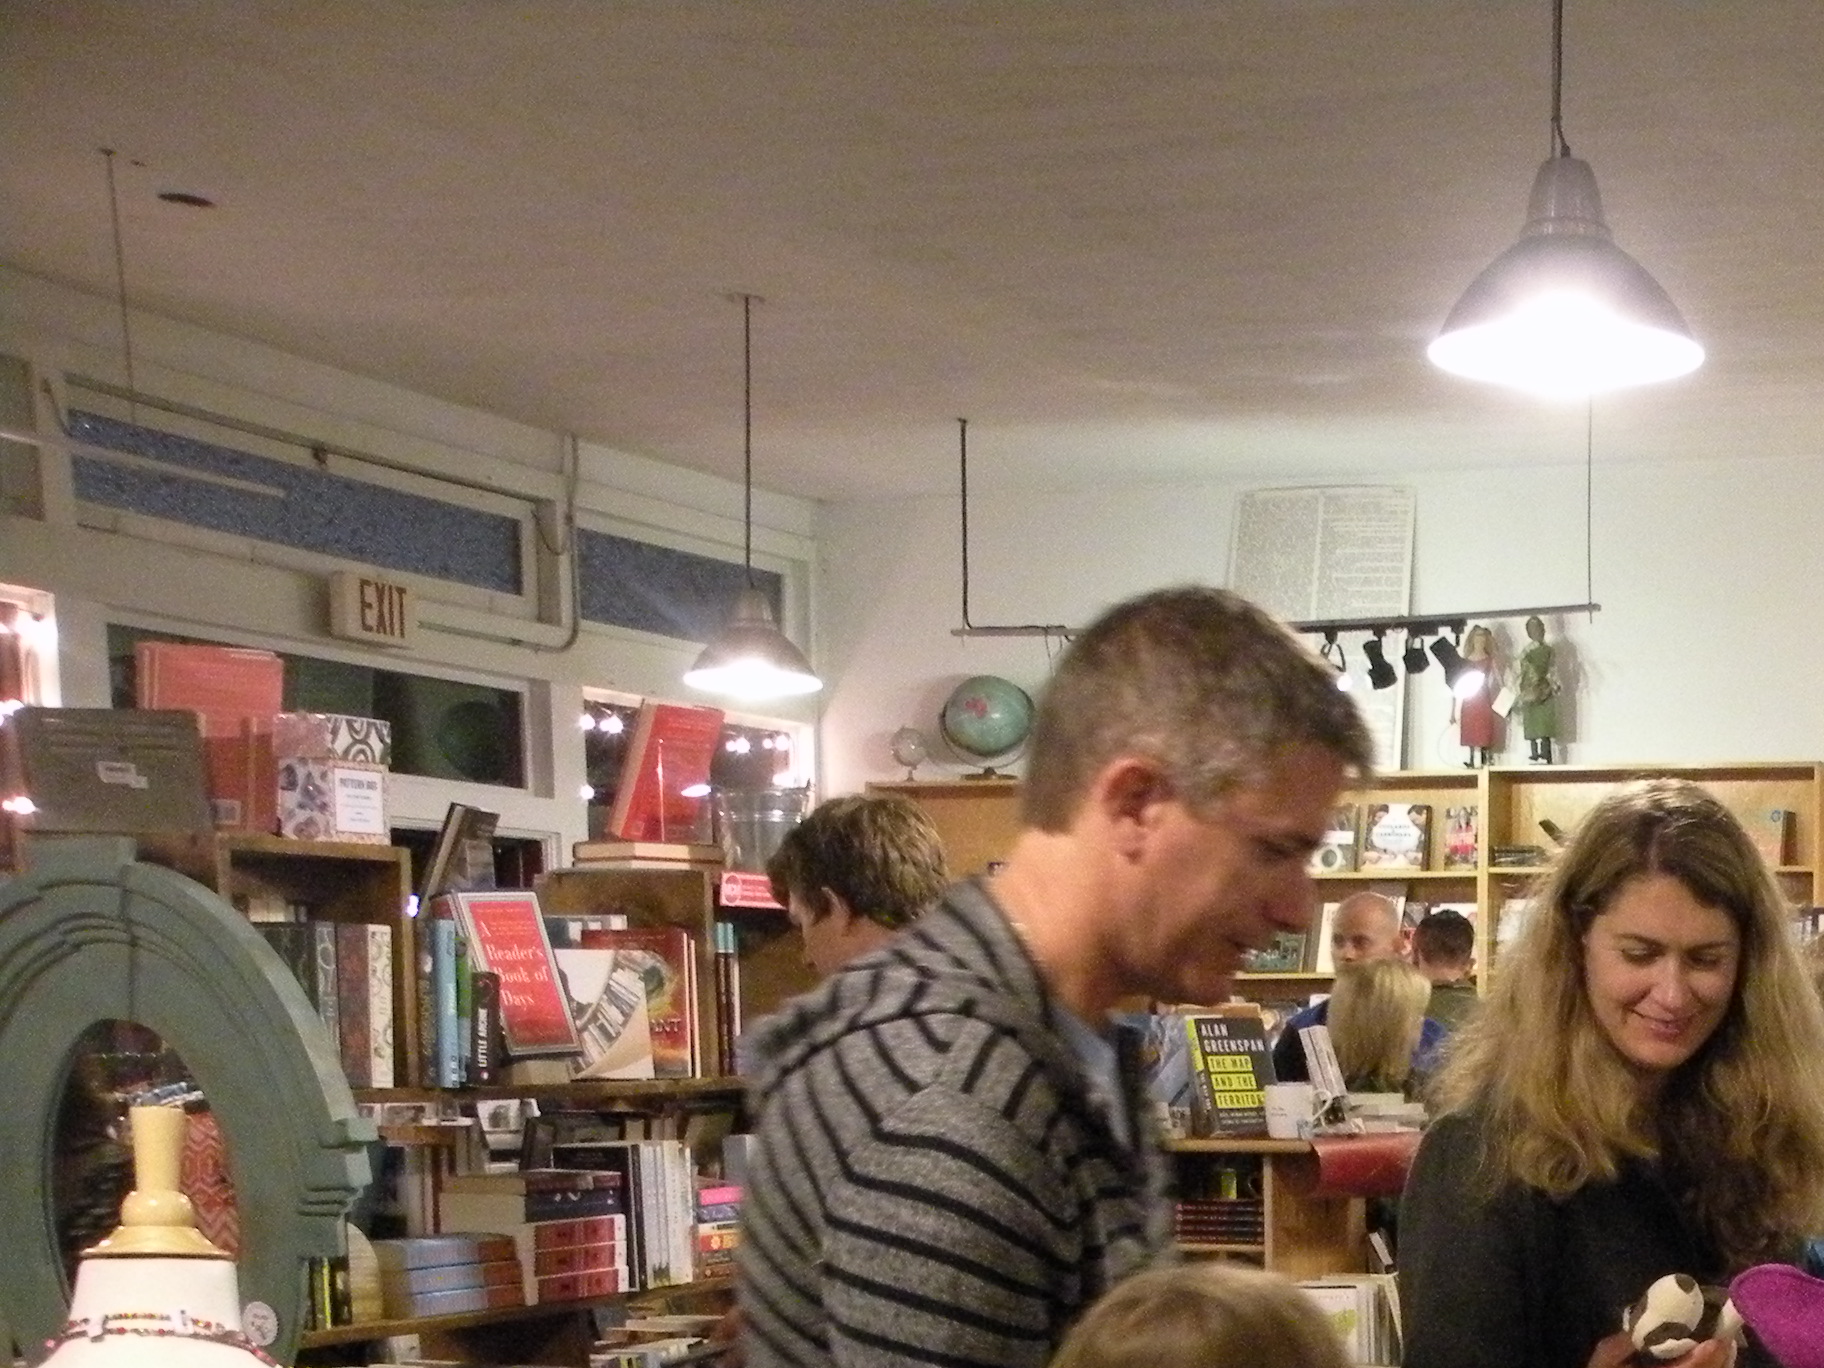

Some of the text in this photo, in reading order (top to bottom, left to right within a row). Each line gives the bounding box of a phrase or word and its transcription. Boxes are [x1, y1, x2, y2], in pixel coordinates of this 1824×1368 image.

[360, 578, 406, 638] EXIT
[480, 921, 491, 937] A
[486, 944, 544, 960] Reader's
[494, 966, 548, 983] Book of
[500, 990, 534, 1011] Days
[478, 1008, 488, 1067] LITTLE ARCHIE
[1201, 1023, 1228, 1037] ALAN
[1204, 1039, 1265, 1052] GREENSPAN
[1210, 1058, 1250, 1069] THE MAP
[1214, 1076, 1254, 1087] AND THE
[1218, 1094, 1265, 1107] TERRITOR
